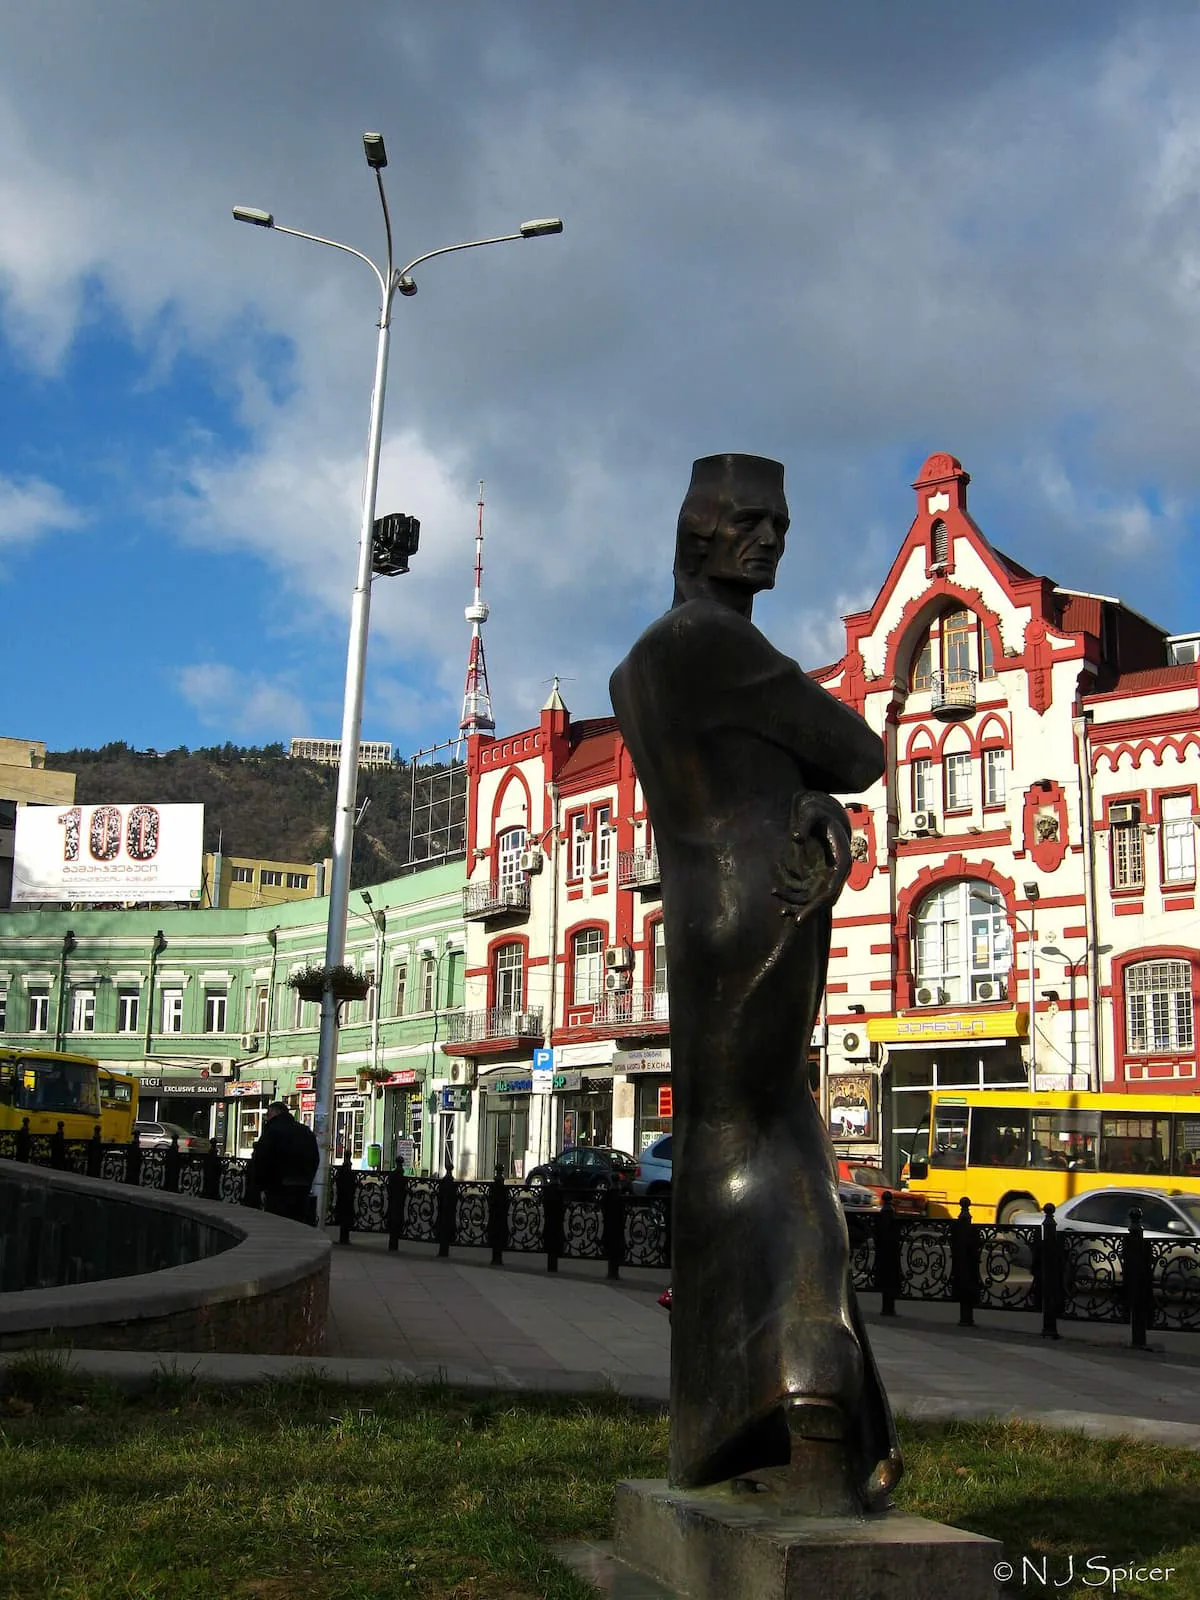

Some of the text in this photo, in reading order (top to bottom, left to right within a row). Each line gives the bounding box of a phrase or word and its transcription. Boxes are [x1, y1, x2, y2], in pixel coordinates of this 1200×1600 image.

[58, 805, 160, 862] 100
[537, 1052, 550, 1066] P
[552, 1074, 566, 1088] SP
[163, 1085, 195, 1093] EXCLUSIVE
